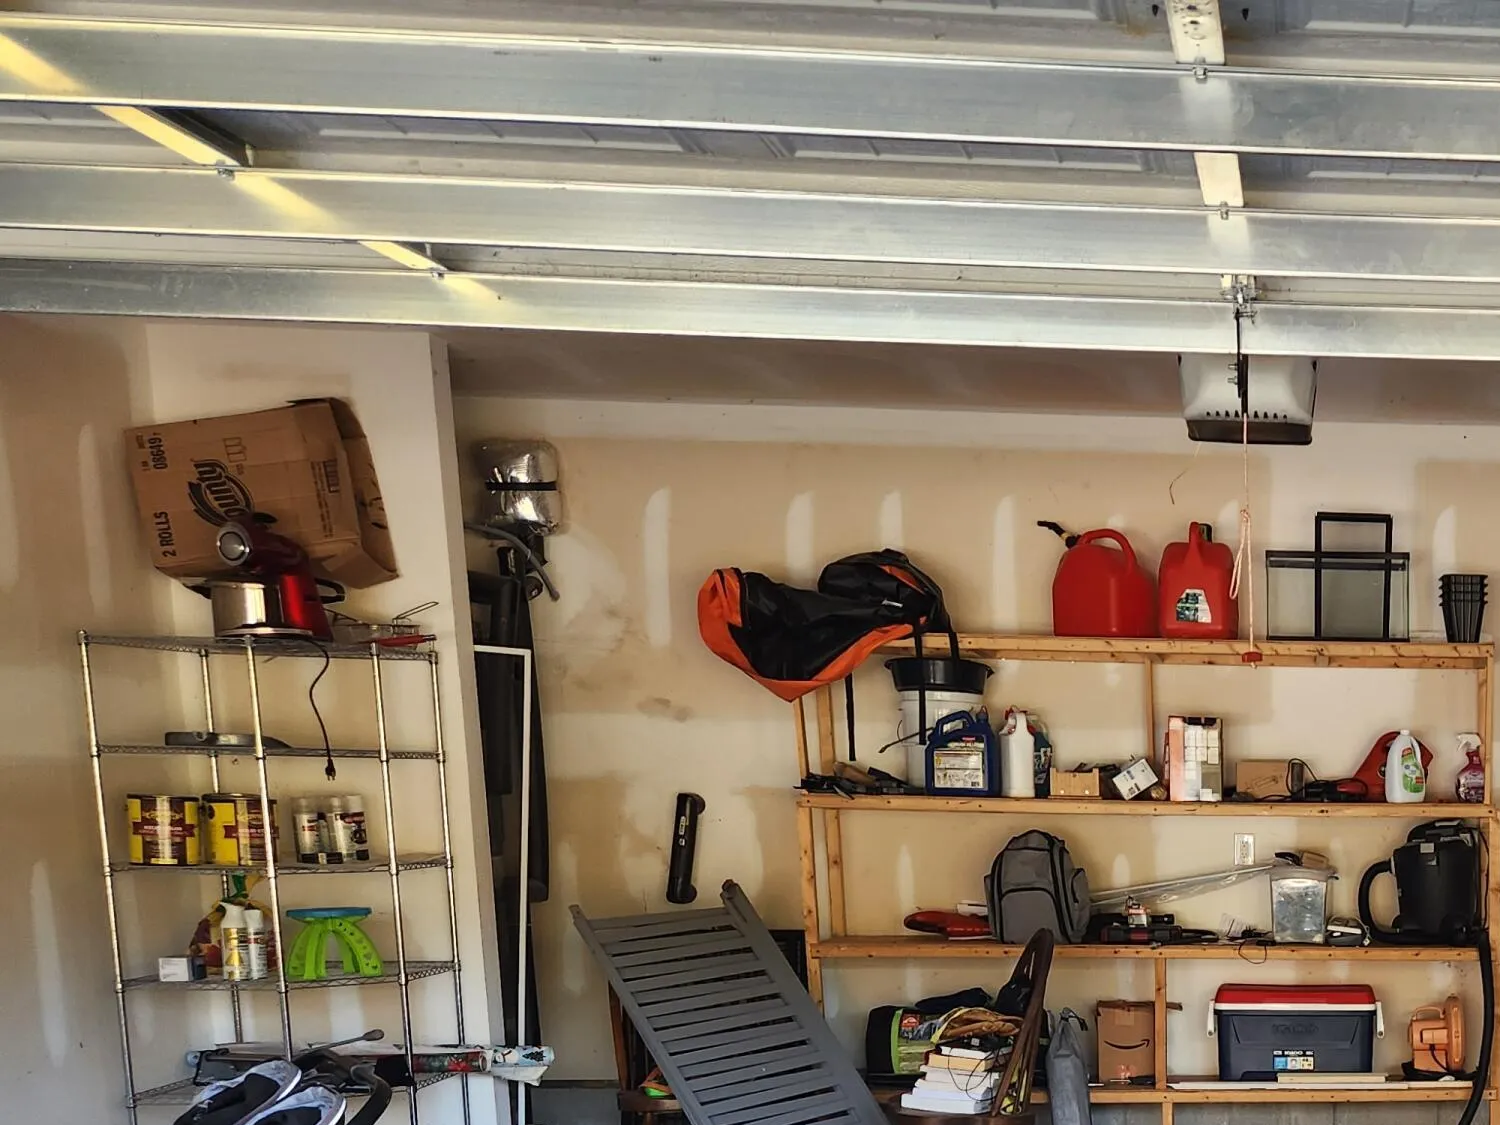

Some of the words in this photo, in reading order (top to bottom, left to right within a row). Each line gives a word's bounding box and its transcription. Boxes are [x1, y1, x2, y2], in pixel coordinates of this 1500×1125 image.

[147, 437, 169, 470] 08649
[153, 511, 175, 548] ROLLS
[162, 549, 177, 558] 2
